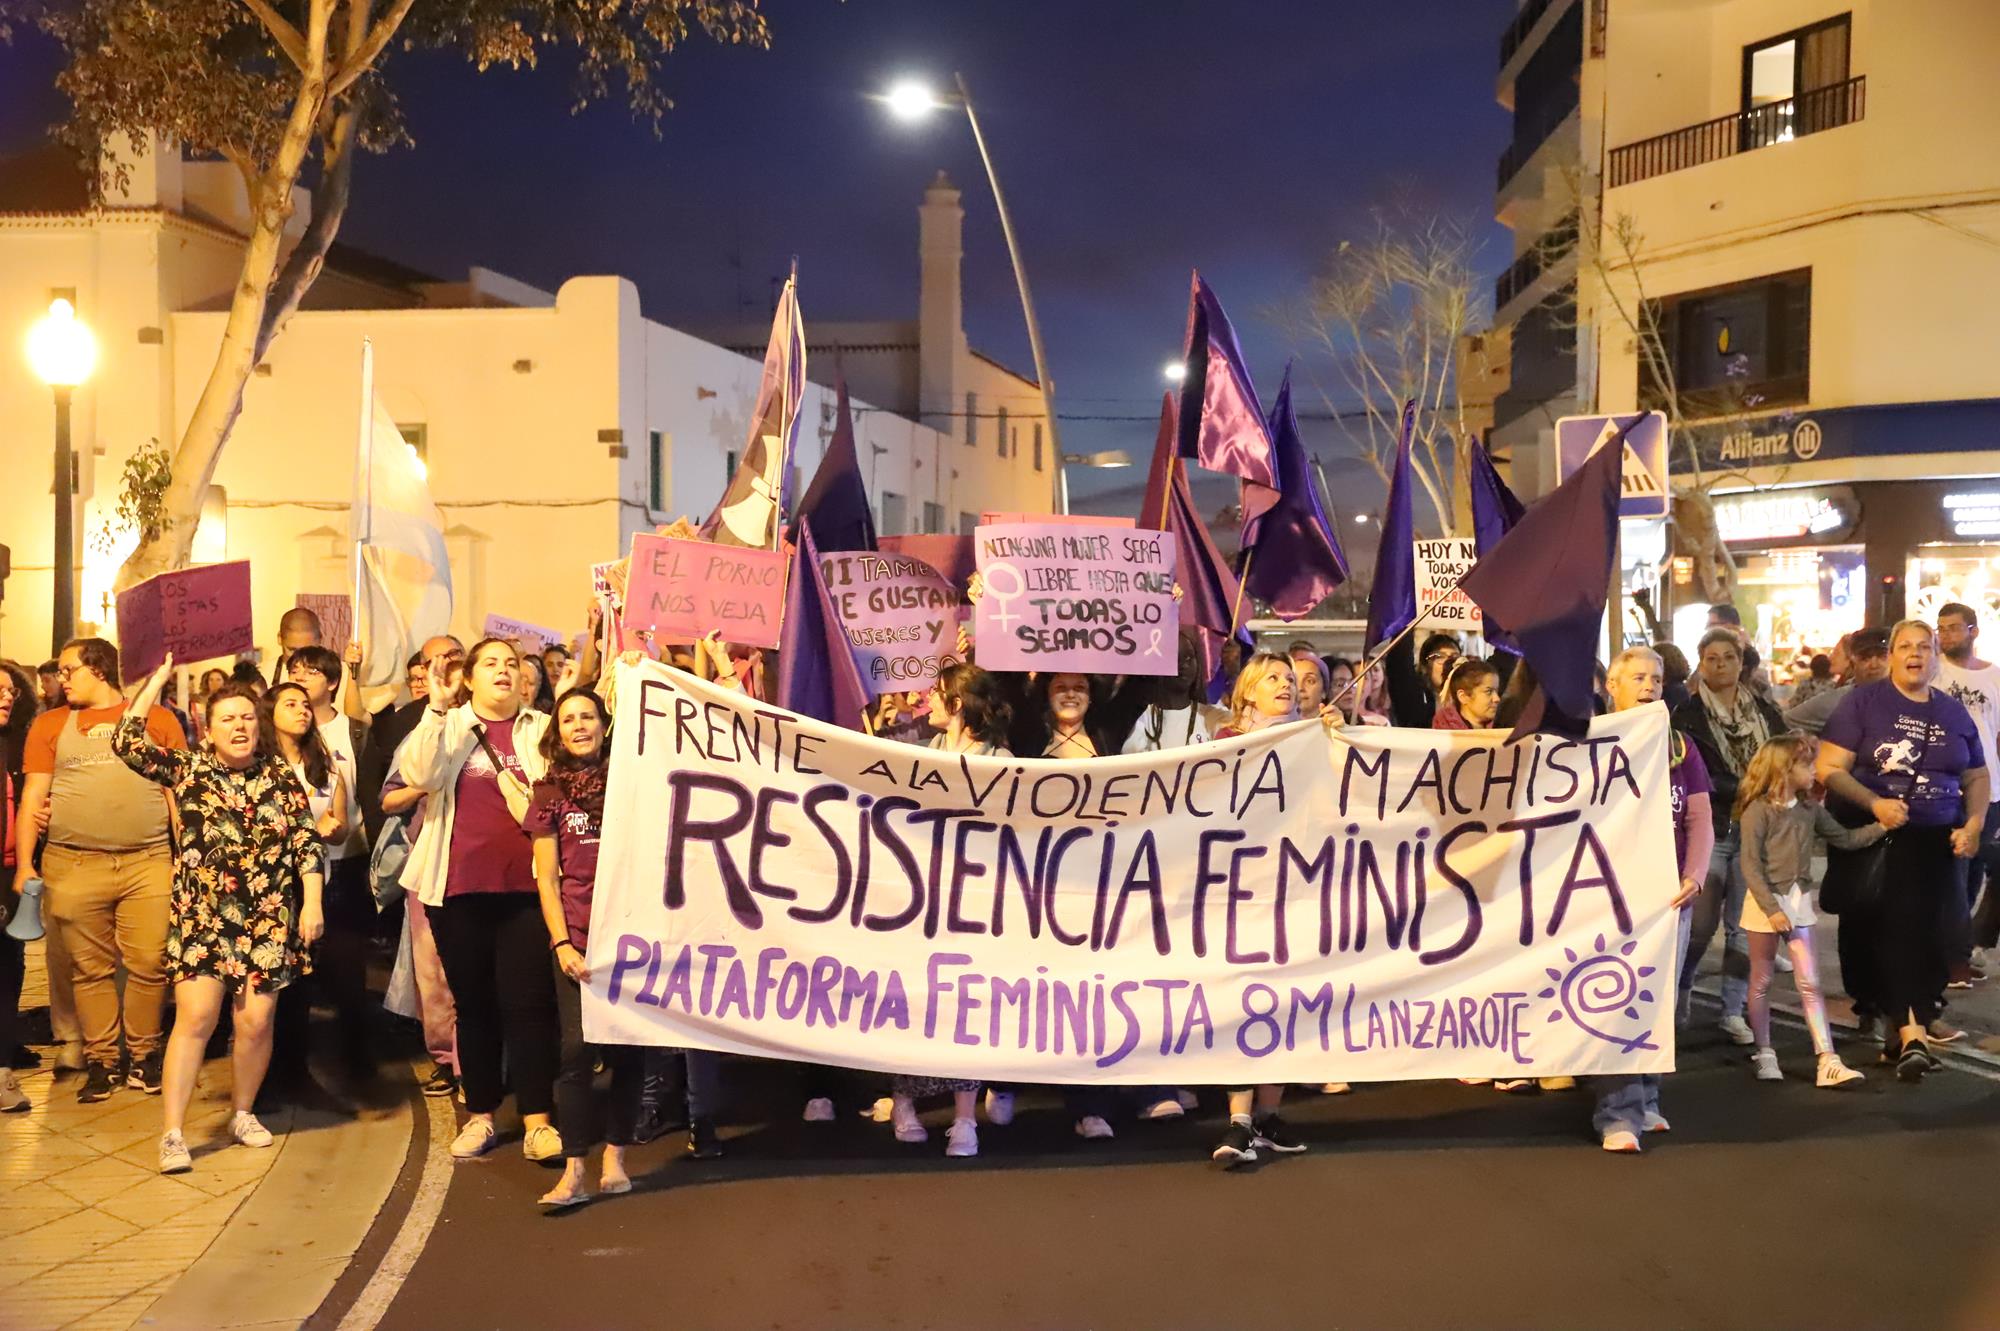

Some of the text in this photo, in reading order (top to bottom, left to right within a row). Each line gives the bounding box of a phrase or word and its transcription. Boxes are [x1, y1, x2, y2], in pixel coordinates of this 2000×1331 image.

[1720, 431, 1789, 461] Allianz
[984, 534, 1162, 564] NINGUNA MUJER SERÁ
[1418, 542, 1478, 559] HOY N
[653, 549, 777, 586] EL PORNO
[1025, 568, 1172, 594] LIBRE HASTA QUE
[1425, 560, 1463, 575] TODAS
[651, 591, 766, 624] NOS VEJA
[869, 586, 959, 613] GUSTAN
[1029, 598, 1162, 625] TODAS LO
[845, 620, 944, 646] UJERES Y
[1015, 624, 1137, 655] SEAMOS
[637, 680, 828, 774] FRENTE
[860, 759, 897, 785] A
[909, 759, 949, 793] LA
[606, 934, 910, 1034] PLATAFORMA
[1236, 981, 1334, 1058] 8M
[1343, 983, 1534, 1064] LANZAROTE
